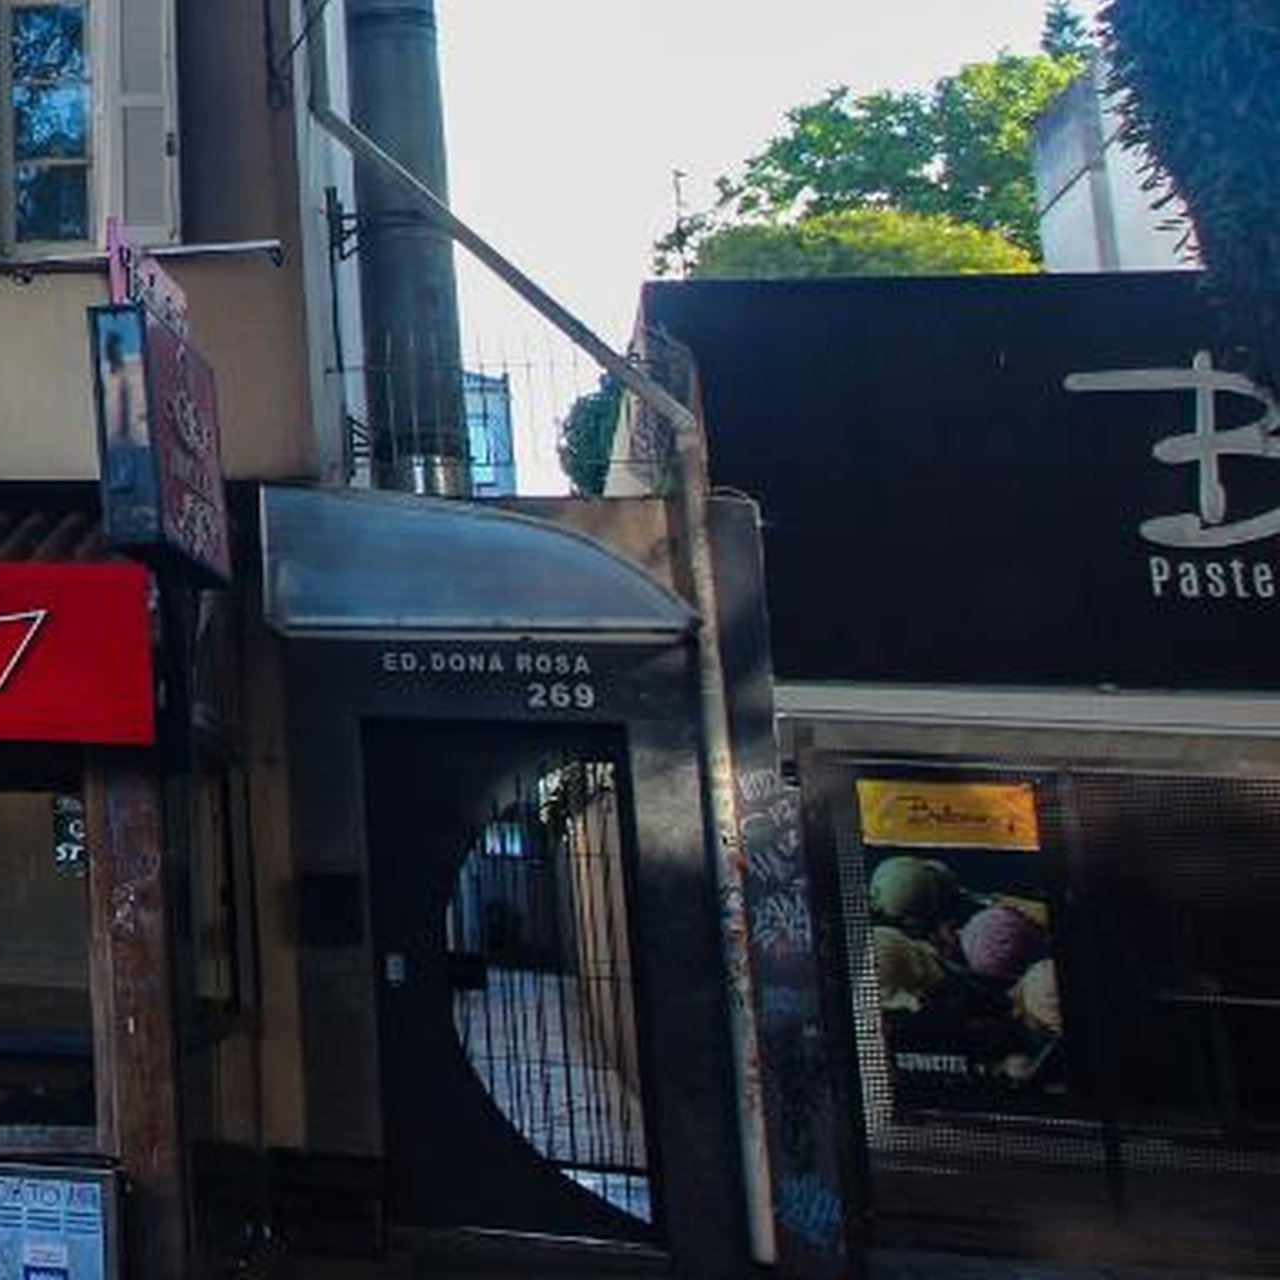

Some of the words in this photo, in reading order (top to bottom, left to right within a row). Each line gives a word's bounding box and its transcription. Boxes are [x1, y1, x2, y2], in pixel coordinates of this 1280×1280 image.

[1149, 556, 1276, 598] Paste
[516, 653, 591, 675] ROSA
[528, 682, 595, 709] 269
